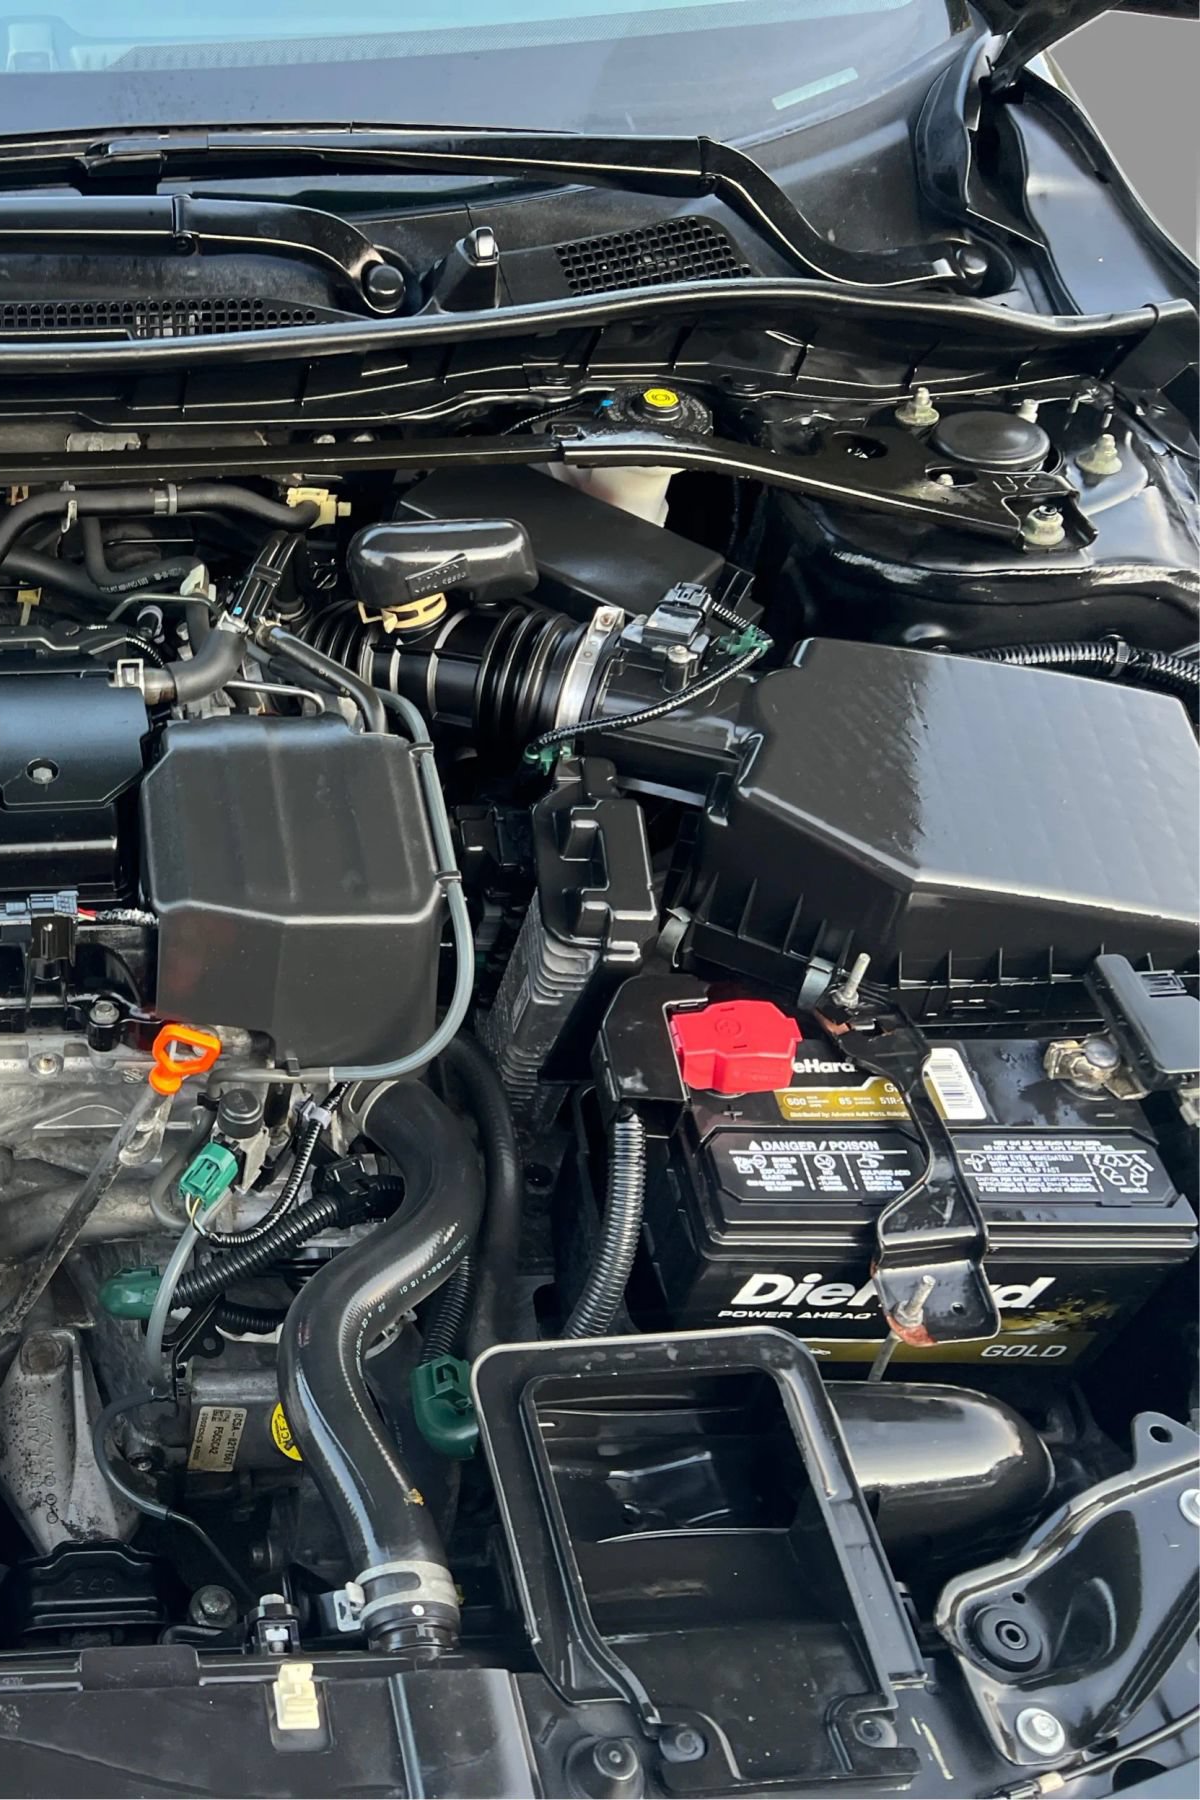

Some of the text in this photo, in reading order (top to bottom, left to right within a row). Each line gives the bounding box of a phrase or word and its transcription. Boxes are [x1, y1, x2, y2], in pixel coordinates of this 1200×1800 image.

[761, 1141, 817, 1150] DANGER
[829, 1141, 880, 1150] POISON
[730, 1273, 1057, 1310] Died
[718, 1310, 795, 1319] POWER
[981, 1344, 1068, 1359] GOLD
